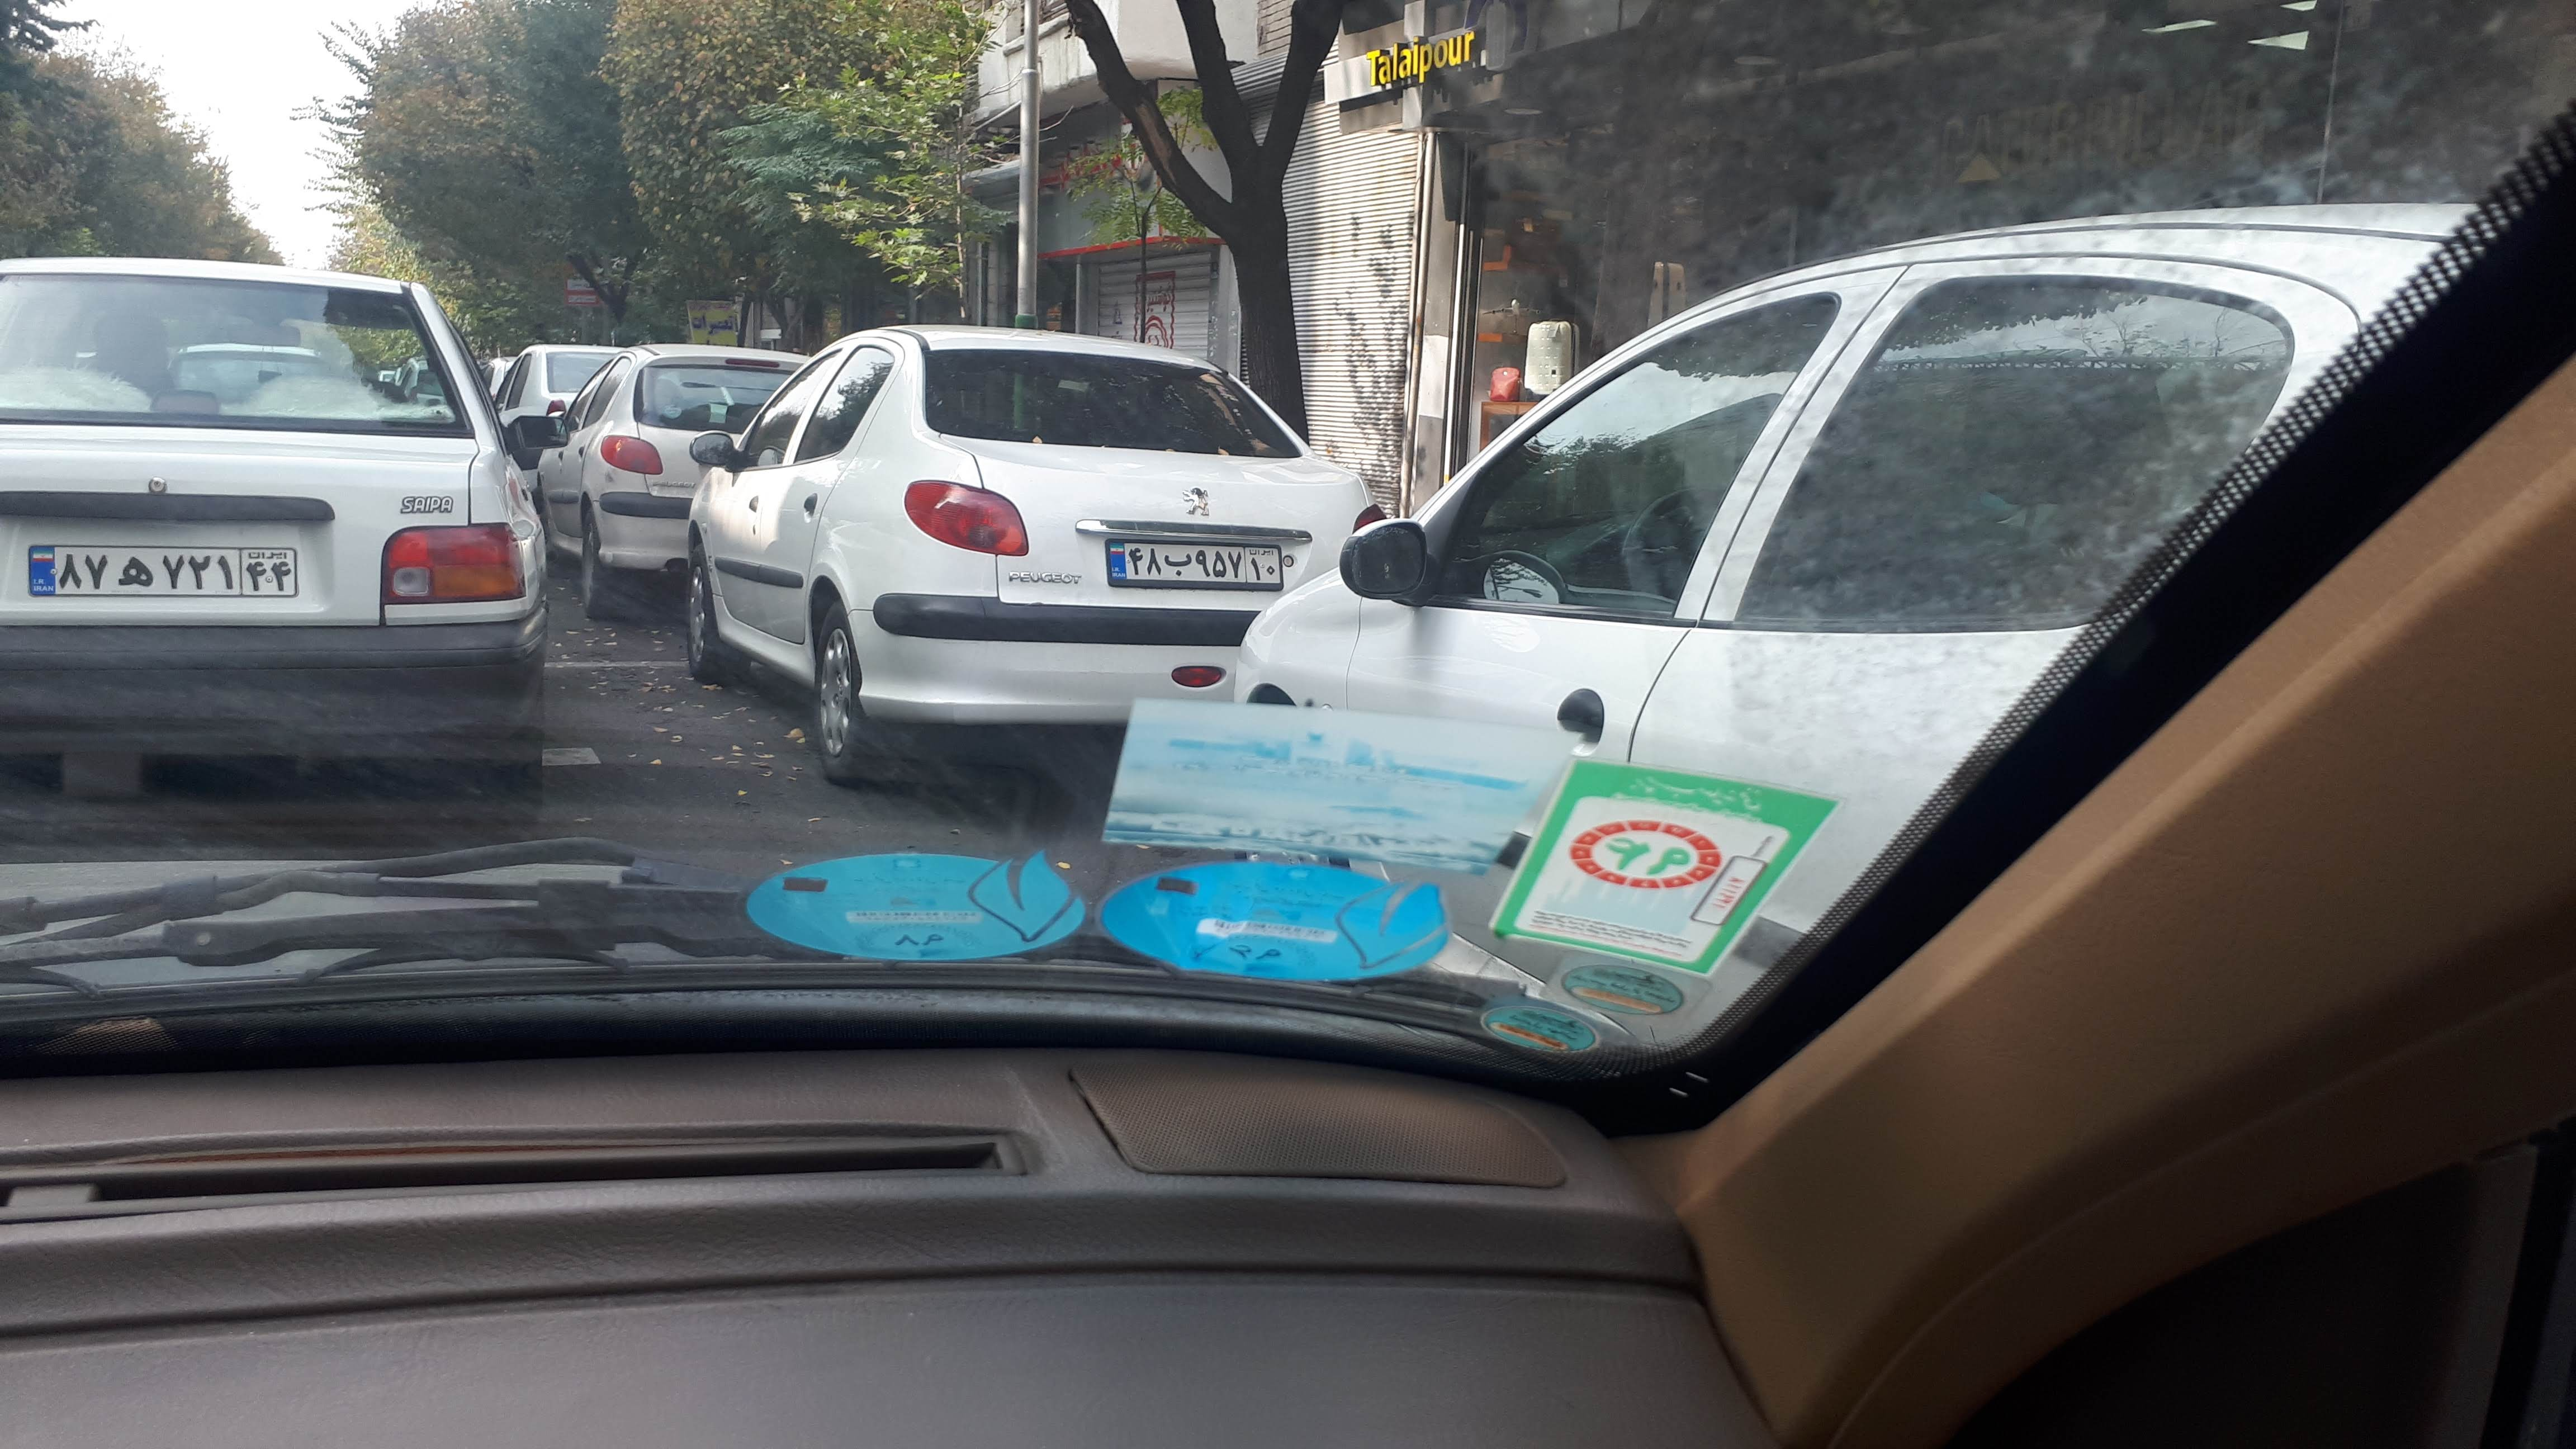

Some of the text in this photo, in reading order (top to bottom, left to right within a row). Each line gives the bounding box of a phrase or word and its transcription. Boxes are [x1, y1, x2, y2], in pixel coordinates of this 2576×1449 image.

[1366, 31, 1475, 86] Talaipour
[400, 496, 454, 514] SAIPA
[246, 561, 291, 591] ۴۴
[1008, 571, 1082, 584] PEUGEOT
